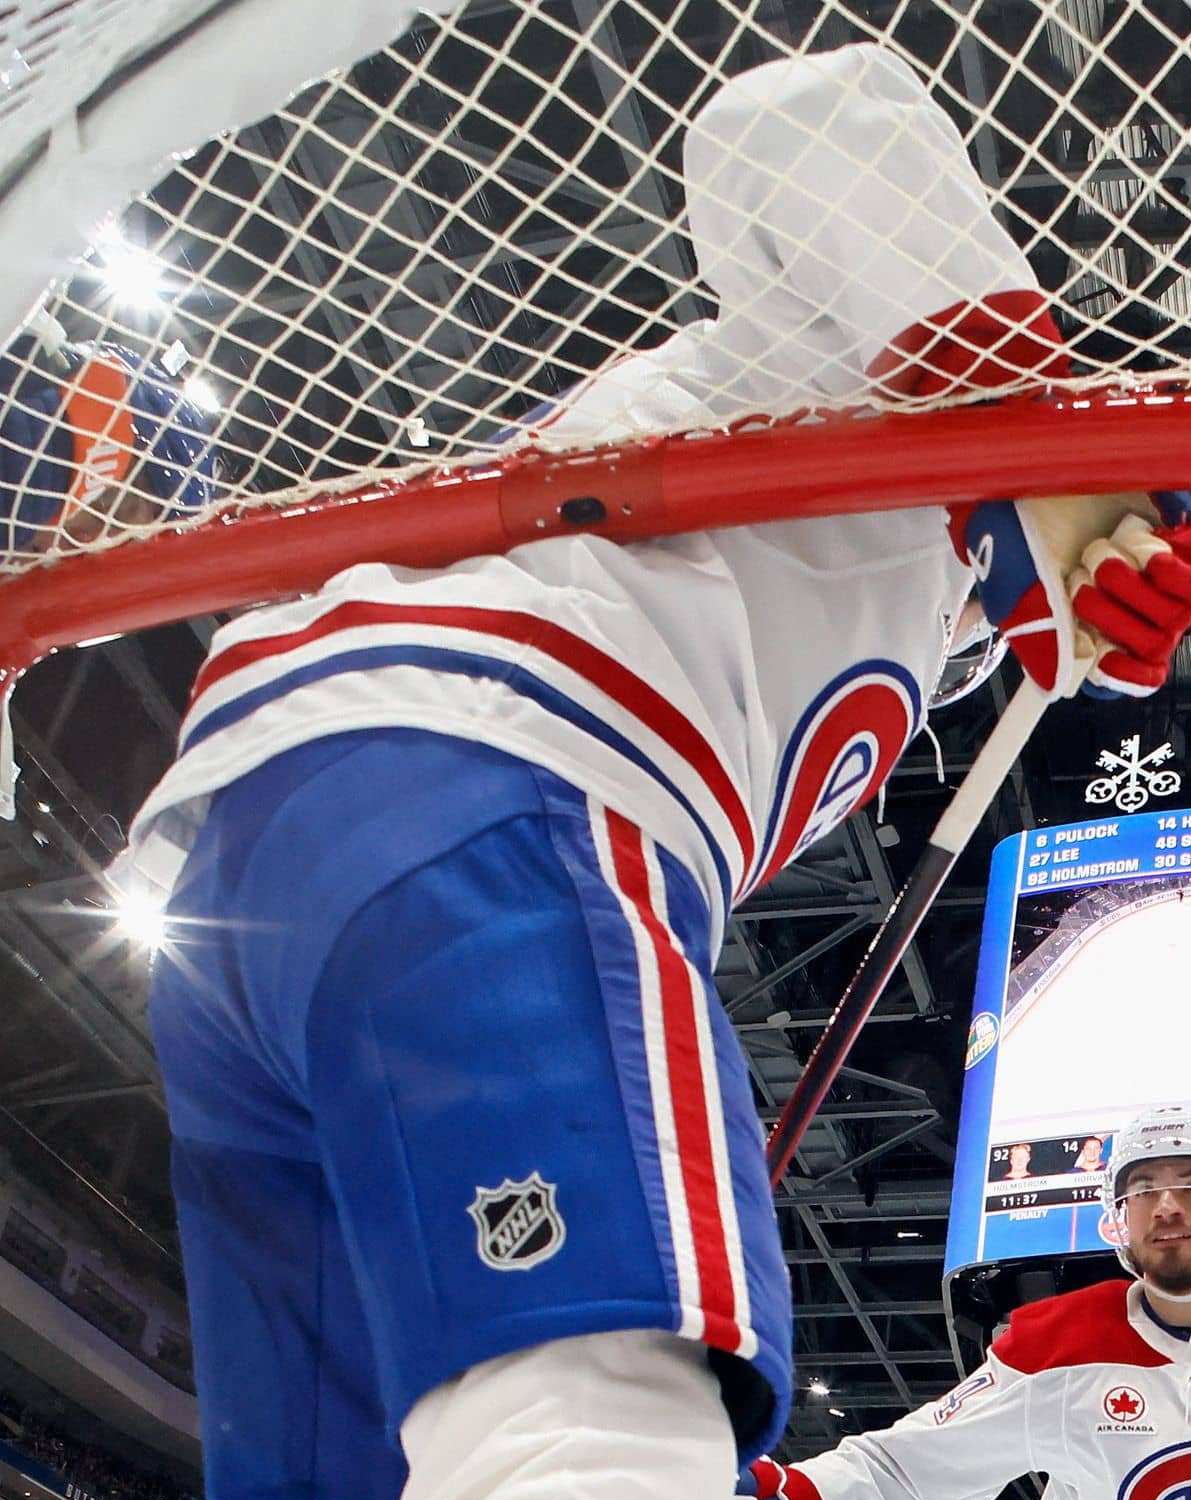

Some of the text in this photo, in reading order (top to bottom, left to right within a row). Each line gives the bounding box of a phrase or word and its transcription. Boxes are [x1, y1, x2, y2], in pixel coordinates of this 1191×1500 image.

[1157, 817, 1177, 831] 14
[1036, 824, 1119, 848] 6 PULOCK
[1155, 836, 1177, 849] 48
[1029, 848, 1080, 868] 27 LEE
[1154, 854, 1176, 869] 30
[1027, 859, 1139, 886] 92 HOLMSTROM
[1062, 1140, 1079, 1153] 14
[993, 1149, 1009, 1162] 92
[1073, 1173, 1107, 1184] HORVA
[1000, 1193, 1039, 1208] 11:37
[1071, 1187, 1102, 1200] 11:4
[1009, 1208, 1048, 1222] PENALTY
[1115, 1424, 1154, 1432] CANADA
